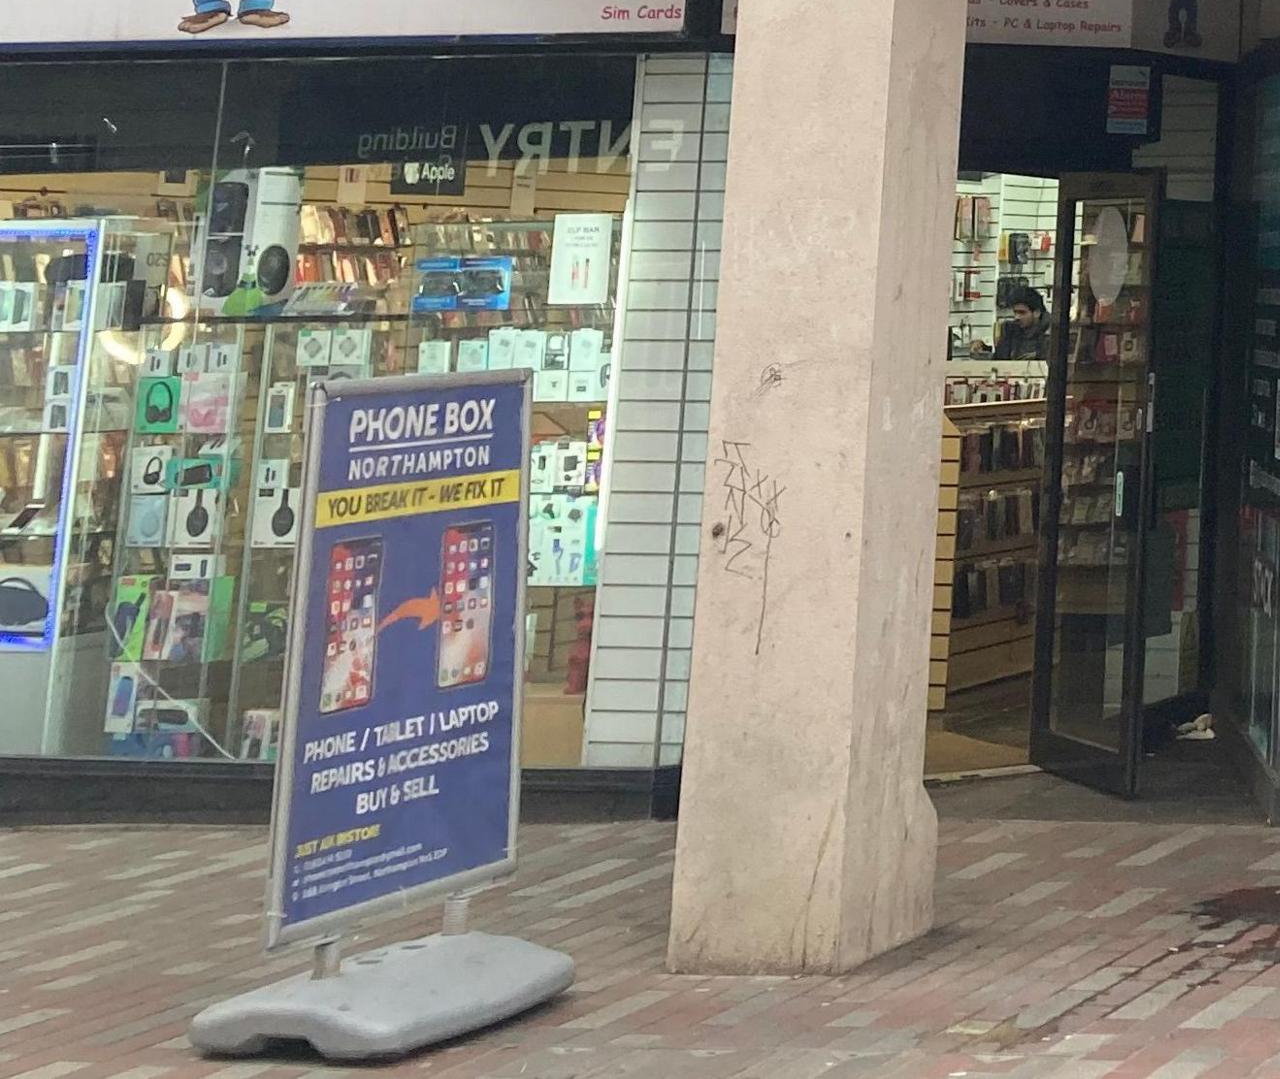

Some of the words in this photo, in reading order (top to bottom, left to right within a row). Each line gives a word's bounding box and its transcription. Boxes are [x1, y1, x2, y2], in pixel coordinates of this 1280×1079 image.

[601, 5, 629, 20] Sim
[637, 4, 682, 19] Cards
[1004, 17, 1018, 29] PC
[1023, 18, 1032, 30] &
[1037, 19, 1076, 33] Laptop
[1080, 21, 1121, 34] Repairs
[421, 163, 456, 184] Apple
[350, 404, 440, 443] PHONE
[444, 399, 496, 432] BOX
[349, 445, 490, 481] NORTHAMPTON
[328, 496, 363, 519] YOU
[365, 489, 408, 514] BREAK
[411, 487, 427, 506] IT
[439, 482, 462, 504] WE
[464, 480, 487, 500] FIX
[491, 477, 505, 497] IT
[304, 731, 356, 764] PHONE
[360, 728, 370, 751] /
[439, 700, 499, 731] LAPTOP
[311, 758, 375, 794] REPAIRS
[387, 732, 490, 775] ACCESSORIES
[356, 790, 389, 815] BUY
[403, 775, 440, 802] SELL
